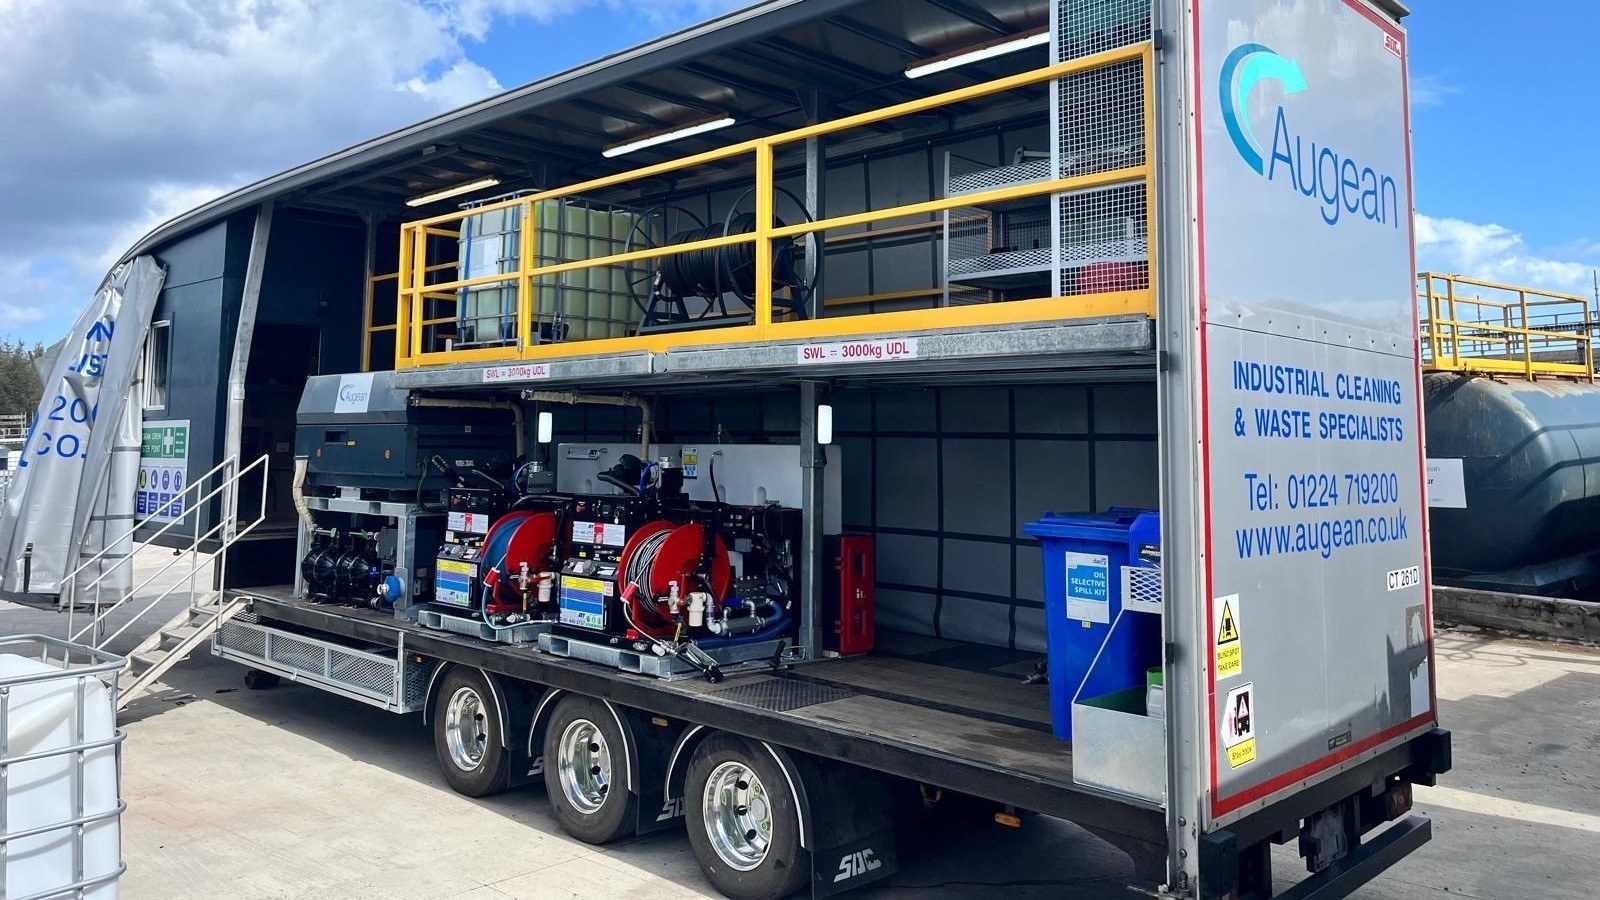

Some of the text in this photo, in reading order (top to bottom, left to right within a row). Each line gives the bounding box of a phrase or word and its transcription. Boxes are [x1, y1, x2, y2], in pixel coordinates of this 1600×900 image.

[1268, 105, 1398, 229] Augean
[803, 347, 826, 360] SWL
[842, 344, 883, 359] 3000kg
[886, 342, 910, 355] UDL
[486, 369, 499, 379] SWL
[507, 366, 531, 379] 3000kg
[532, 365, 545, 376] UDL
[1233, 360, 1401, 404] INDUSTRIAL CLEANING
[345, 389, 369, 405] Augean
[1234, 407, 1403, 442] & WASTE SPECIALISTS
[1244, 473, 1398, 511] Tel: 01224 719200
[1236, 508, 1408, 559] www.augean.co.uk
[1070, 577, 1106, 588] SELECTIVE
[1093, 571, 1106, 579] OIL
[1389, 568, 1418, 589] CT 261D
[1074, 586, 1106, 597] SPILL KIT
[833, 848, 882, 883] SDC
